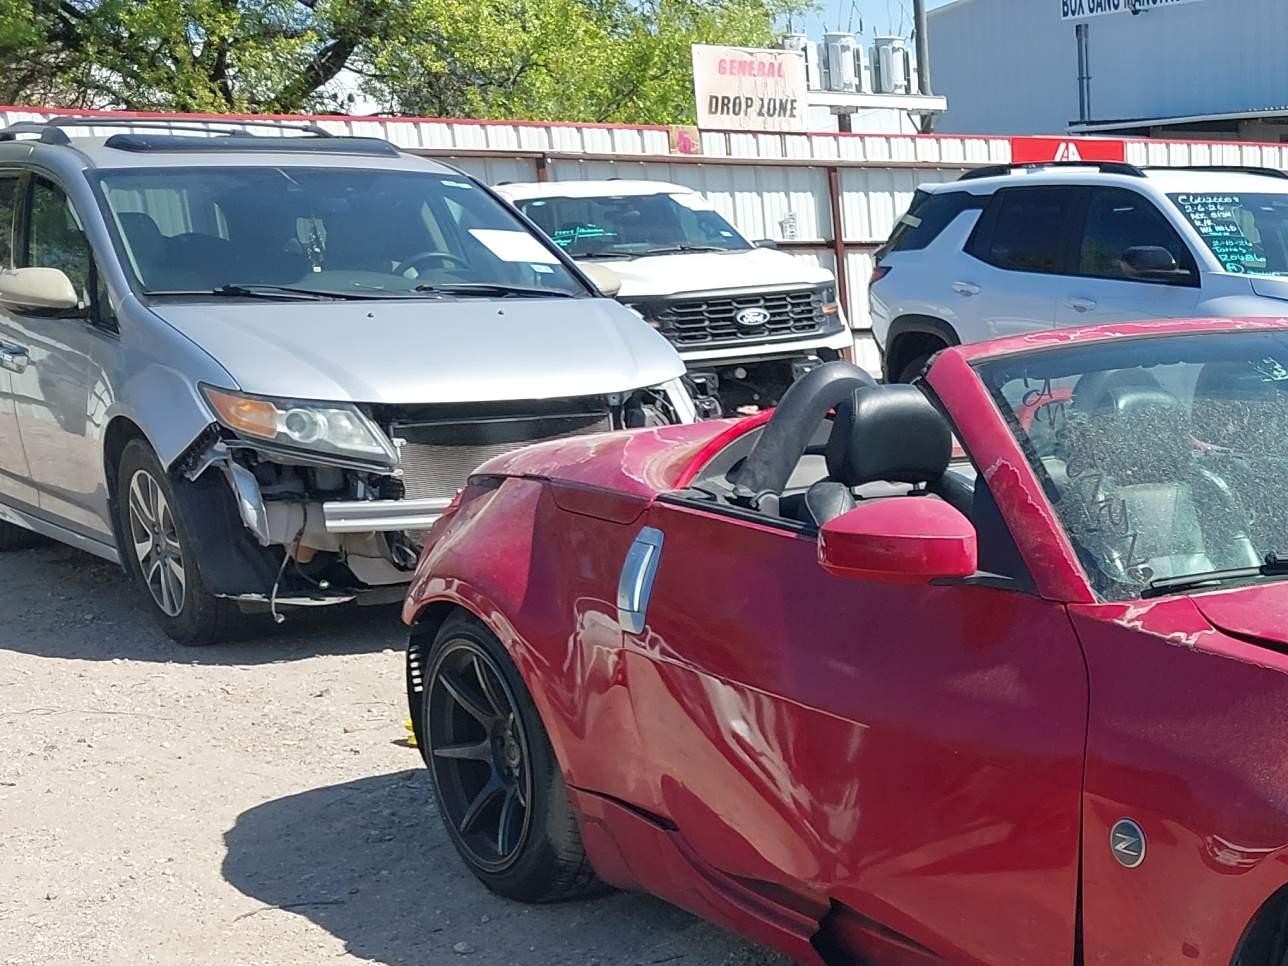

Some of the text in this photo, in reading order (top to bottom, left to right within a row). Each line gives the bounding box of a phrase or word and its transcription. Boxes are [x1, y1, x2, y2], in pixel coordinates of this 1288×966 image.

[718, 58, 784, 77] GENERAL
[708, 95, 798, 118] DROP ZONE
